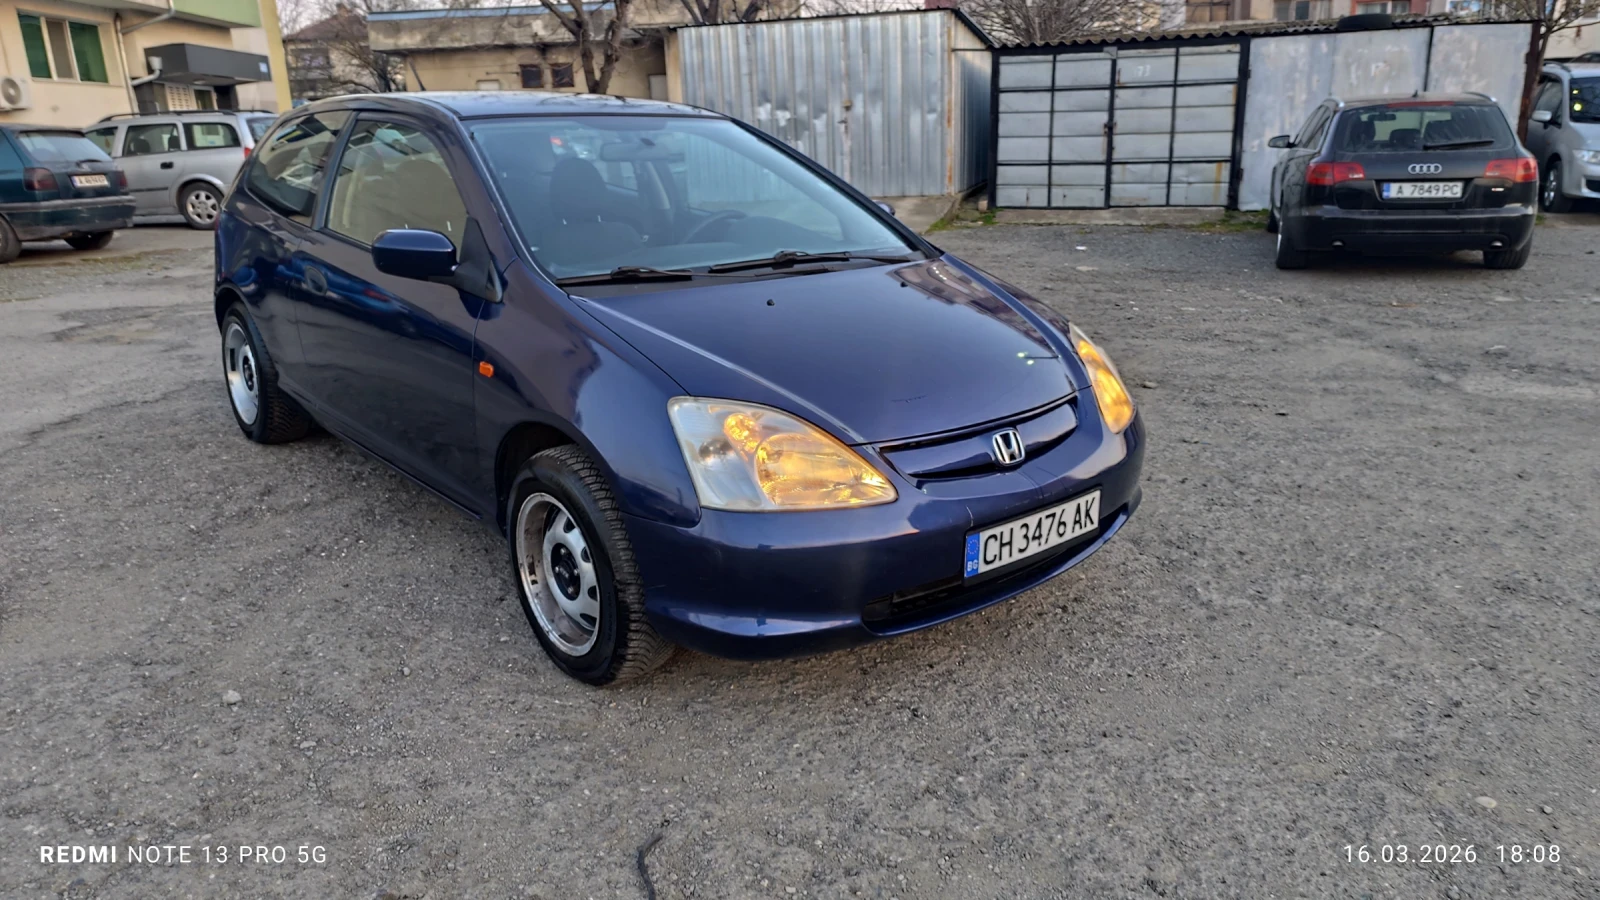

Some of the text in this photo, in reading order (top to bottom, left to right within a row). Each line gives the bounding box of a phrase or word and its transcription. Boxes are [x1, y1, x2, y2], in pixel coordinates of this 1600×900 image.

[1396, 184, 1404, 196] A
[1410, 184, 1440, 196] 7849
[1072, 497, 1096, 533] AK
[967, 560, 978, 571] BG
